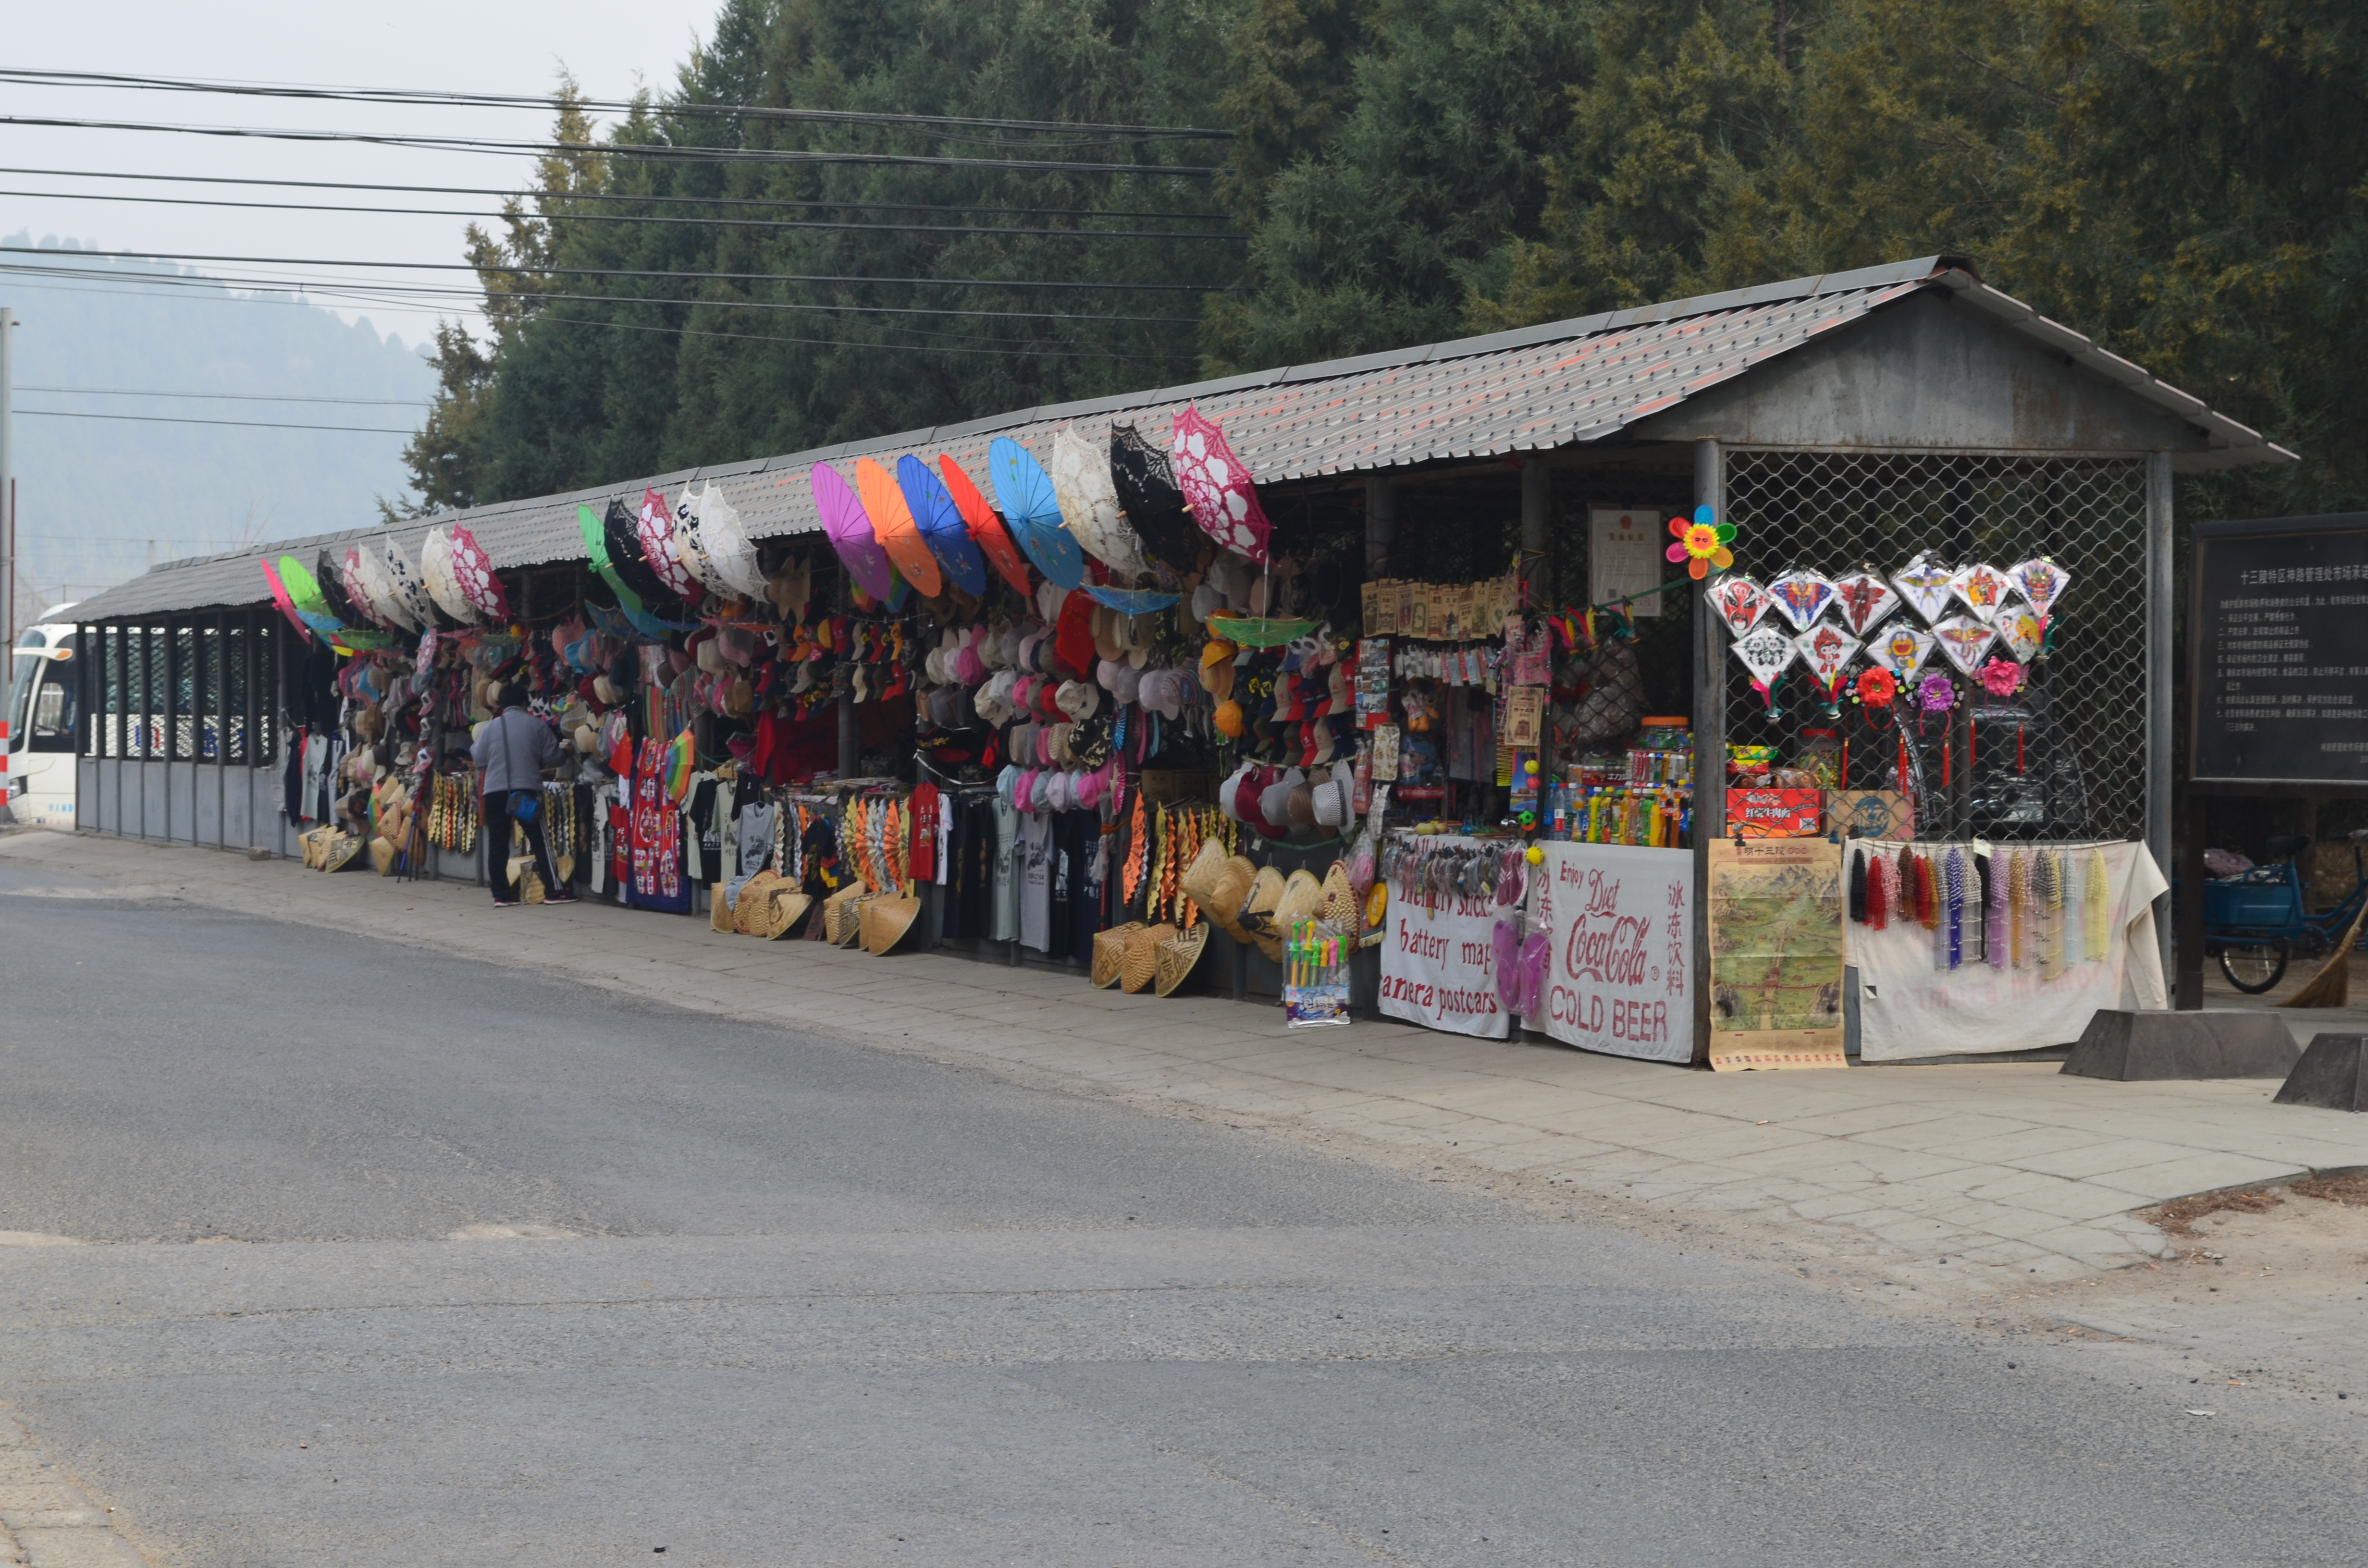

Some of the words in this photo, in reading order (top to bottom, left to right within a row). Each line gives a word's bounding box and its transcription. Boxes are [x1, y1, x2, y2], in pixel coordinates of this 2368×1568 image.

[1560, 860, 1584, 889] Enjoy
[1585, 868, 1620, 912] Diet
[1400, 918, 1450, 970] battery
[1666, 880, 1685, 997] 冰冻饮料
[1550, 985, 1604, 1033] COLD
[1613, 999, 1668, 1042] BEER
